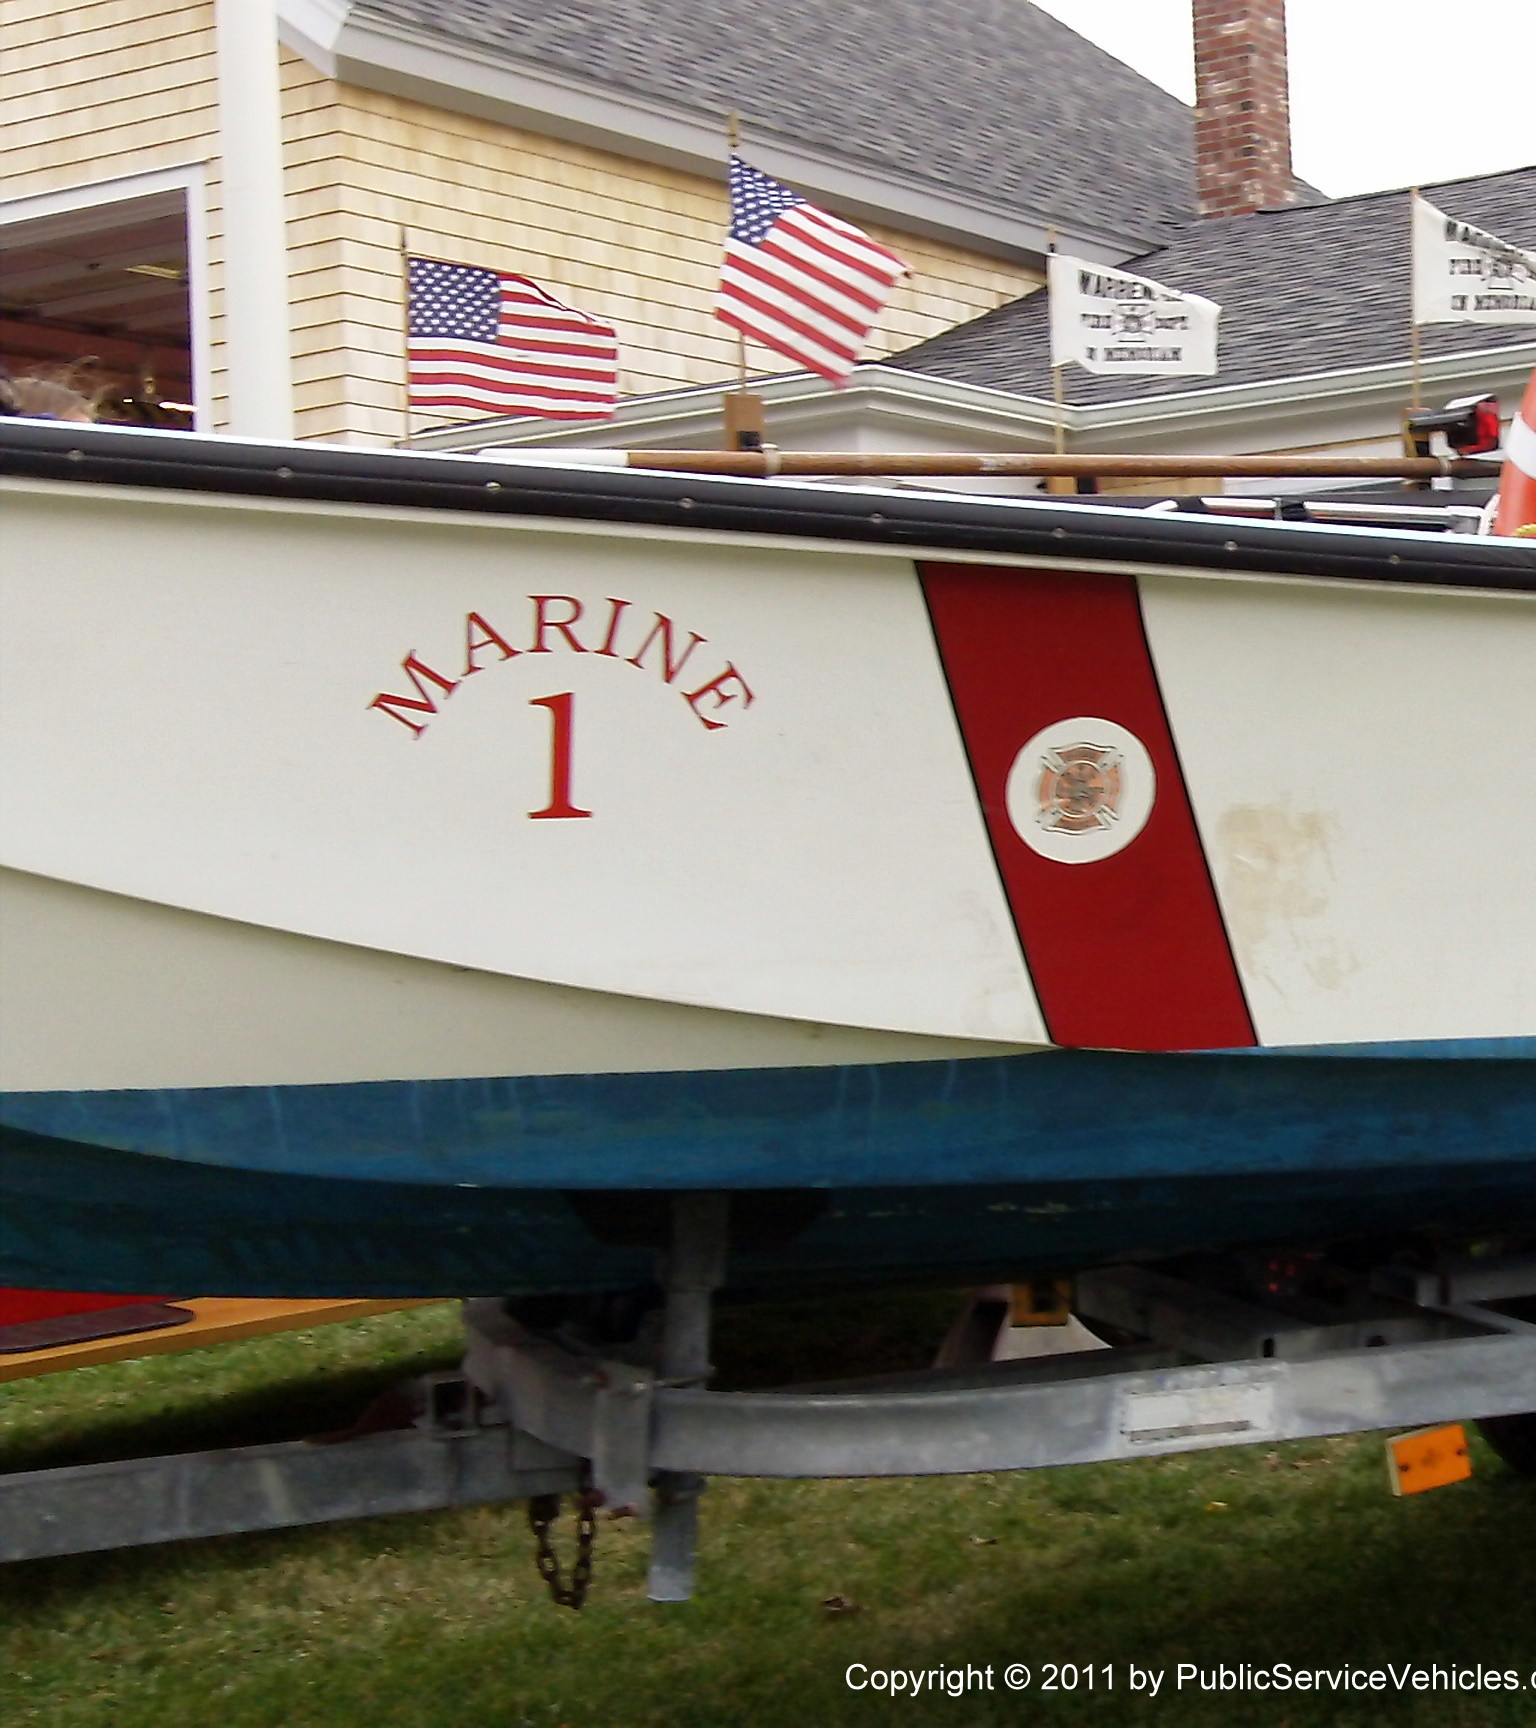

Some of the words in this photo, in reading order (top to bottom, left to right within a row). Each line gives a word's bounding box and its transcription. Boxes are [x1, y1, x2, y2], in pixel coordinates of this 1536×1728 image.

[1079, 269, 1155, 301] WARREN
[369, 593, 756, 740] MARINE
[528, 691, 593, 820] 1
